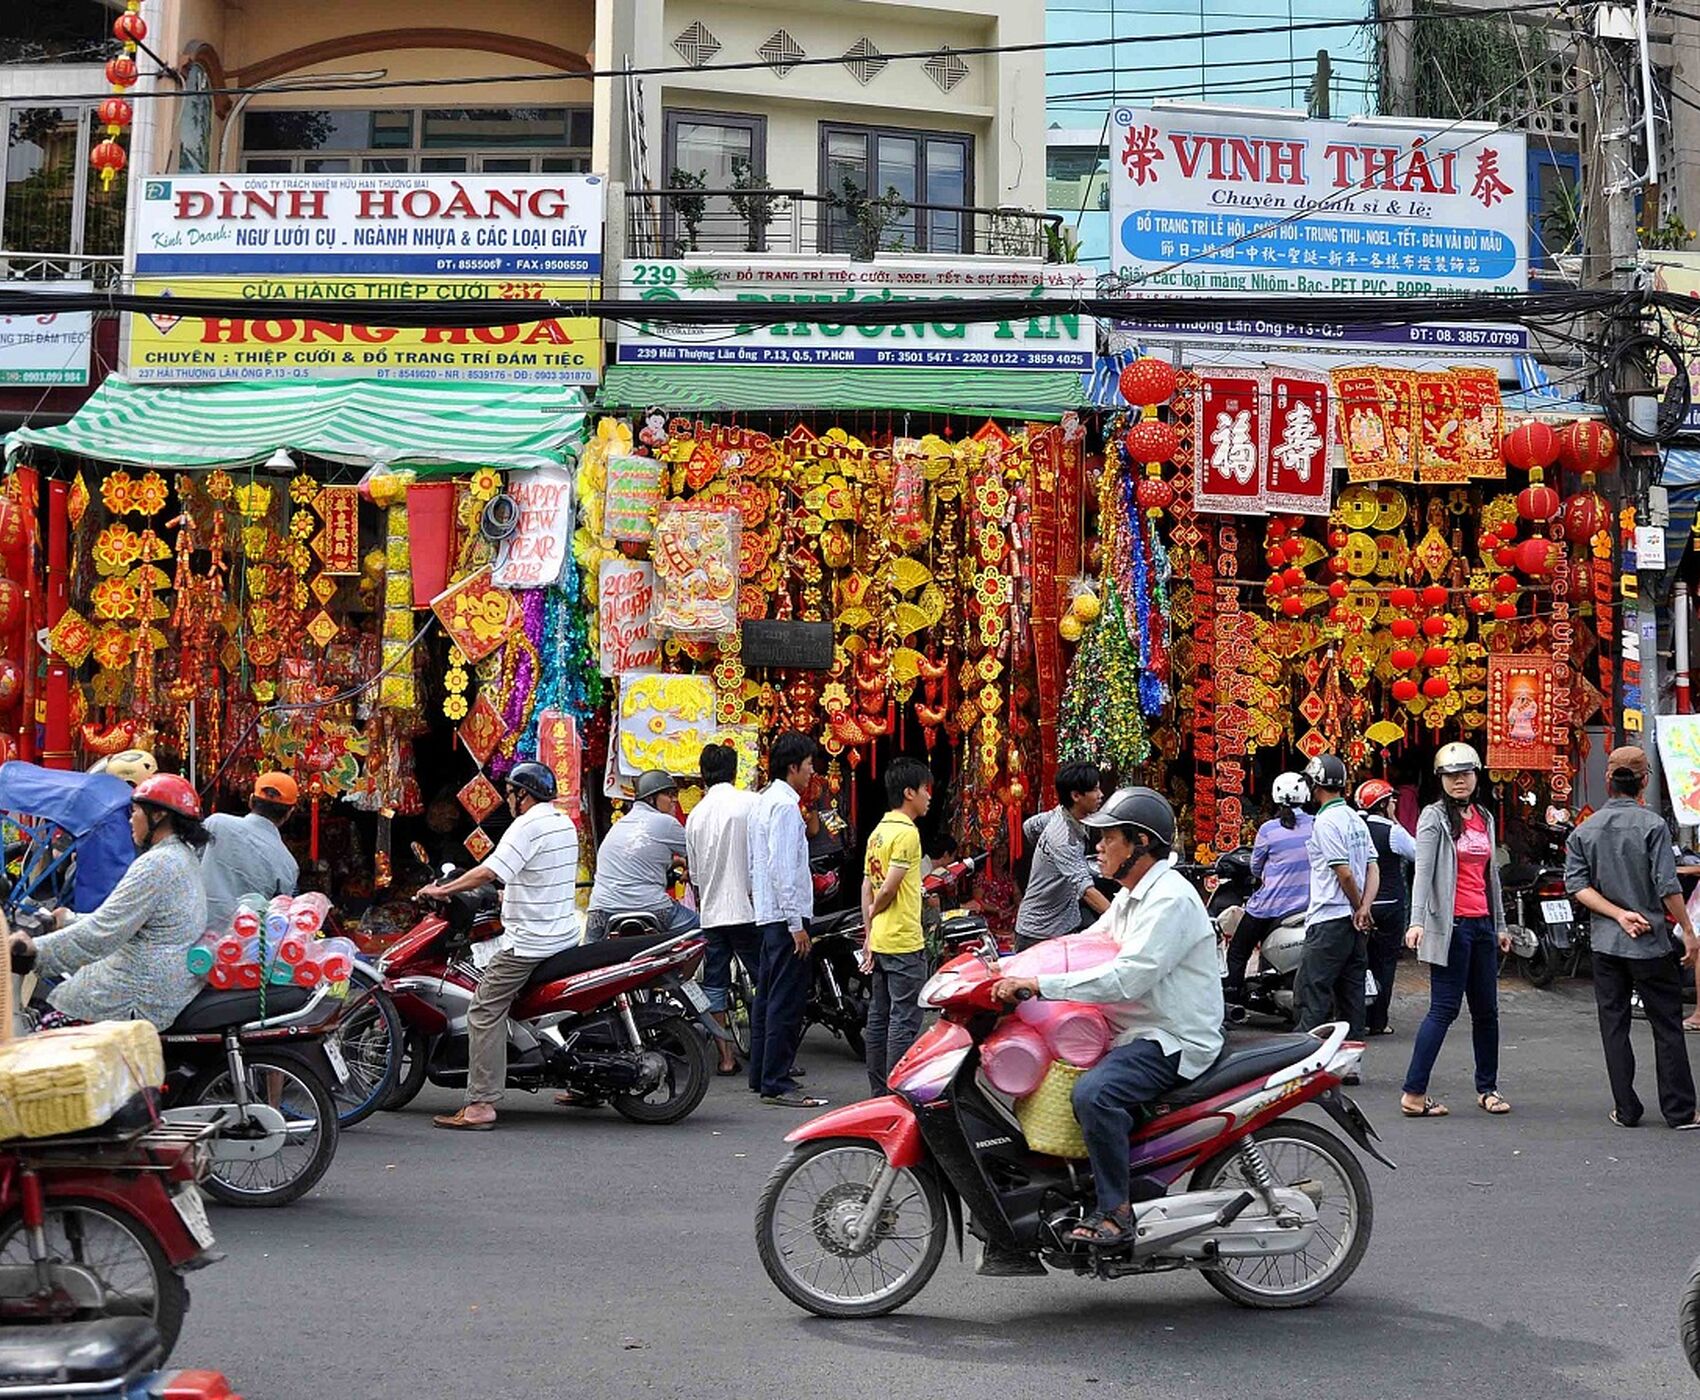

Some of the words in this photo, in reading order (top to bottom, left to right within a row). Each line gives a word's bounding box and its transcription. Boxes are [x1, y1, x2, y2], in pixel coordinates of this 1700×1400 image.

[1168, 132, 1307, 186] VINH
[1323, 137, 1458, 195] THÁI
[1470, 147, 1513, 208] 泰
[245, 179, 268, 189] CÔNG
[271, 180, 280, 189] TY
[174, 181, 329, 221] ĐÌNH
[355, 181, 569, 221] HOÀNG
[1211, 189, 1285, 209] Chuyên
[1386, 200, 1402, 214] &
[151, 230, 183, 249] Kinh
[189, 225, 232, 246] Doanh:
[274, 225, 310, 246] LƯỚI
[316, 229, 335, 249] CỤ
[354, 225, 408, 247] NGÀNH
[413, 228, 456, 250] NHỰA
[461, 232, 472, 247] &
[477, 225, 507, 247] CÁC
[513, 229, 547, 250] LOẠI
[552, 225, 588, 248] GIẤY
[1155, 217, 1189, 234] TRANG
[1191, 216, 1209, 235] TRÍ
[1304, 227, 1338, 242] TRUNG
[1340, 229, 1360, 244] THU
[1366, 230, 1391, 246] NOEL
[1397, 227, 1416, 247] TẾT
[545, 260, 589, 270] 9506550
[632, 265, 677, 286] 239
[758, 271, 799, 282] TRANG
[803, 269, 824, 282] TRÍ
[829, 270, 857, 284] TIỆC
[965, 275, 974, 284] &
[242, 279, 286, 300] CỬA
[295, 279, 356, 300] HÀNG
[436, 281, 490, 300] CƯỚI
[498, 282, 546, 301] 237
[1182, 269, 1206, 292] loại
[1251, 274, 1288, 291] Nhôm
[1298, 276, 1322, 297] Bạc
[1332, 278, 1357, 293] PET
[1362, 279, 1387, 297] PVC
[1410, 329, 1432, 341] ĐT:
[1437, 330, 1454, 342] 08.
[1458, 331, 1519, 344] 3857.0799
[145, 349, 216, 365] CHUYÊN
[235, 350, 288, 369] THIỆP
[294, 348, 336, 365] CƯỚI
[342, 353, 355, 365] &
[363, 347, 388, 364] ĐỒ
[394, 353, 455, 366] TRANG
[460, 350, 490, 366] TRÍ
[496, 351, 537, 367] ĐÁM
[543, 352, 585, 369] TIỆC
[637, 348, 658, 358] 239
[659, 347, 676, 359] Hải
[679, 348, 716, 361] Thượng
[738, 347, 757, 361] Ông
[764, 350, 790, 361] P.13,
[792, 350, 813, 362] Q.5,
[816, 350, 856, 361] TP.HCM
[878, 352, 895, 362] ĐT:
[898, 352, 924, 362] 3501
[927, 352, 953, 362] 5471
[963, 353, 989, 363] 2202
[992, 353, 1018, 363] 0122
[1027, 354, 1054, 364] 3859
[1056, 355, 1084, 365] 4025
[139, 369, 155, 378] 237
[241, 368, 263, 379] ÔNG
[293, 369, 310, 378] Q.5
[1210, 410, 1258, 485] 福
[1272, 400, 1324, 483] 壽
[507, 483, 568, 507] HAPPY
[507, 536, 558, 561] YEAR
[604, 571, 645, 597] 2012
[976, 1136, 1012, 1149] HONDA
